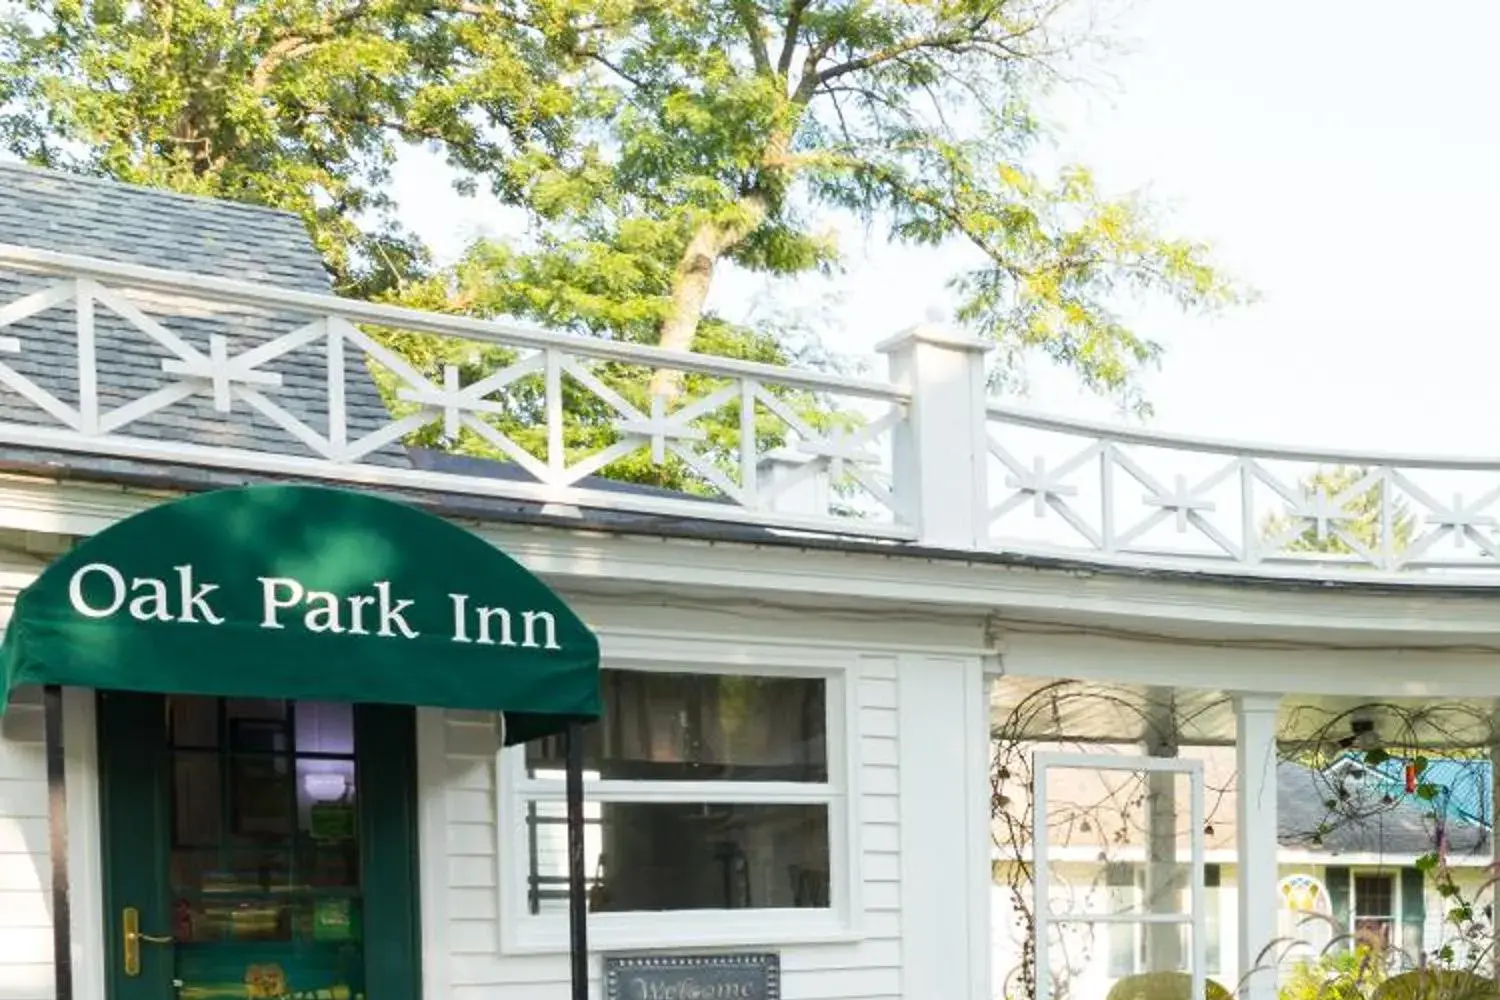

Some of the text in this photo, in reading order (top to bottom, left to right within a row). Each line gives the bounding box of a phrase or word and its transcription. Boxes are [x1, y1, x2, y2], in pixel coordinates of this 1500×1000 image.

[69, 563, 562, 650] Oak Park Inn
[633, 976, 754, 1000] Welcome
